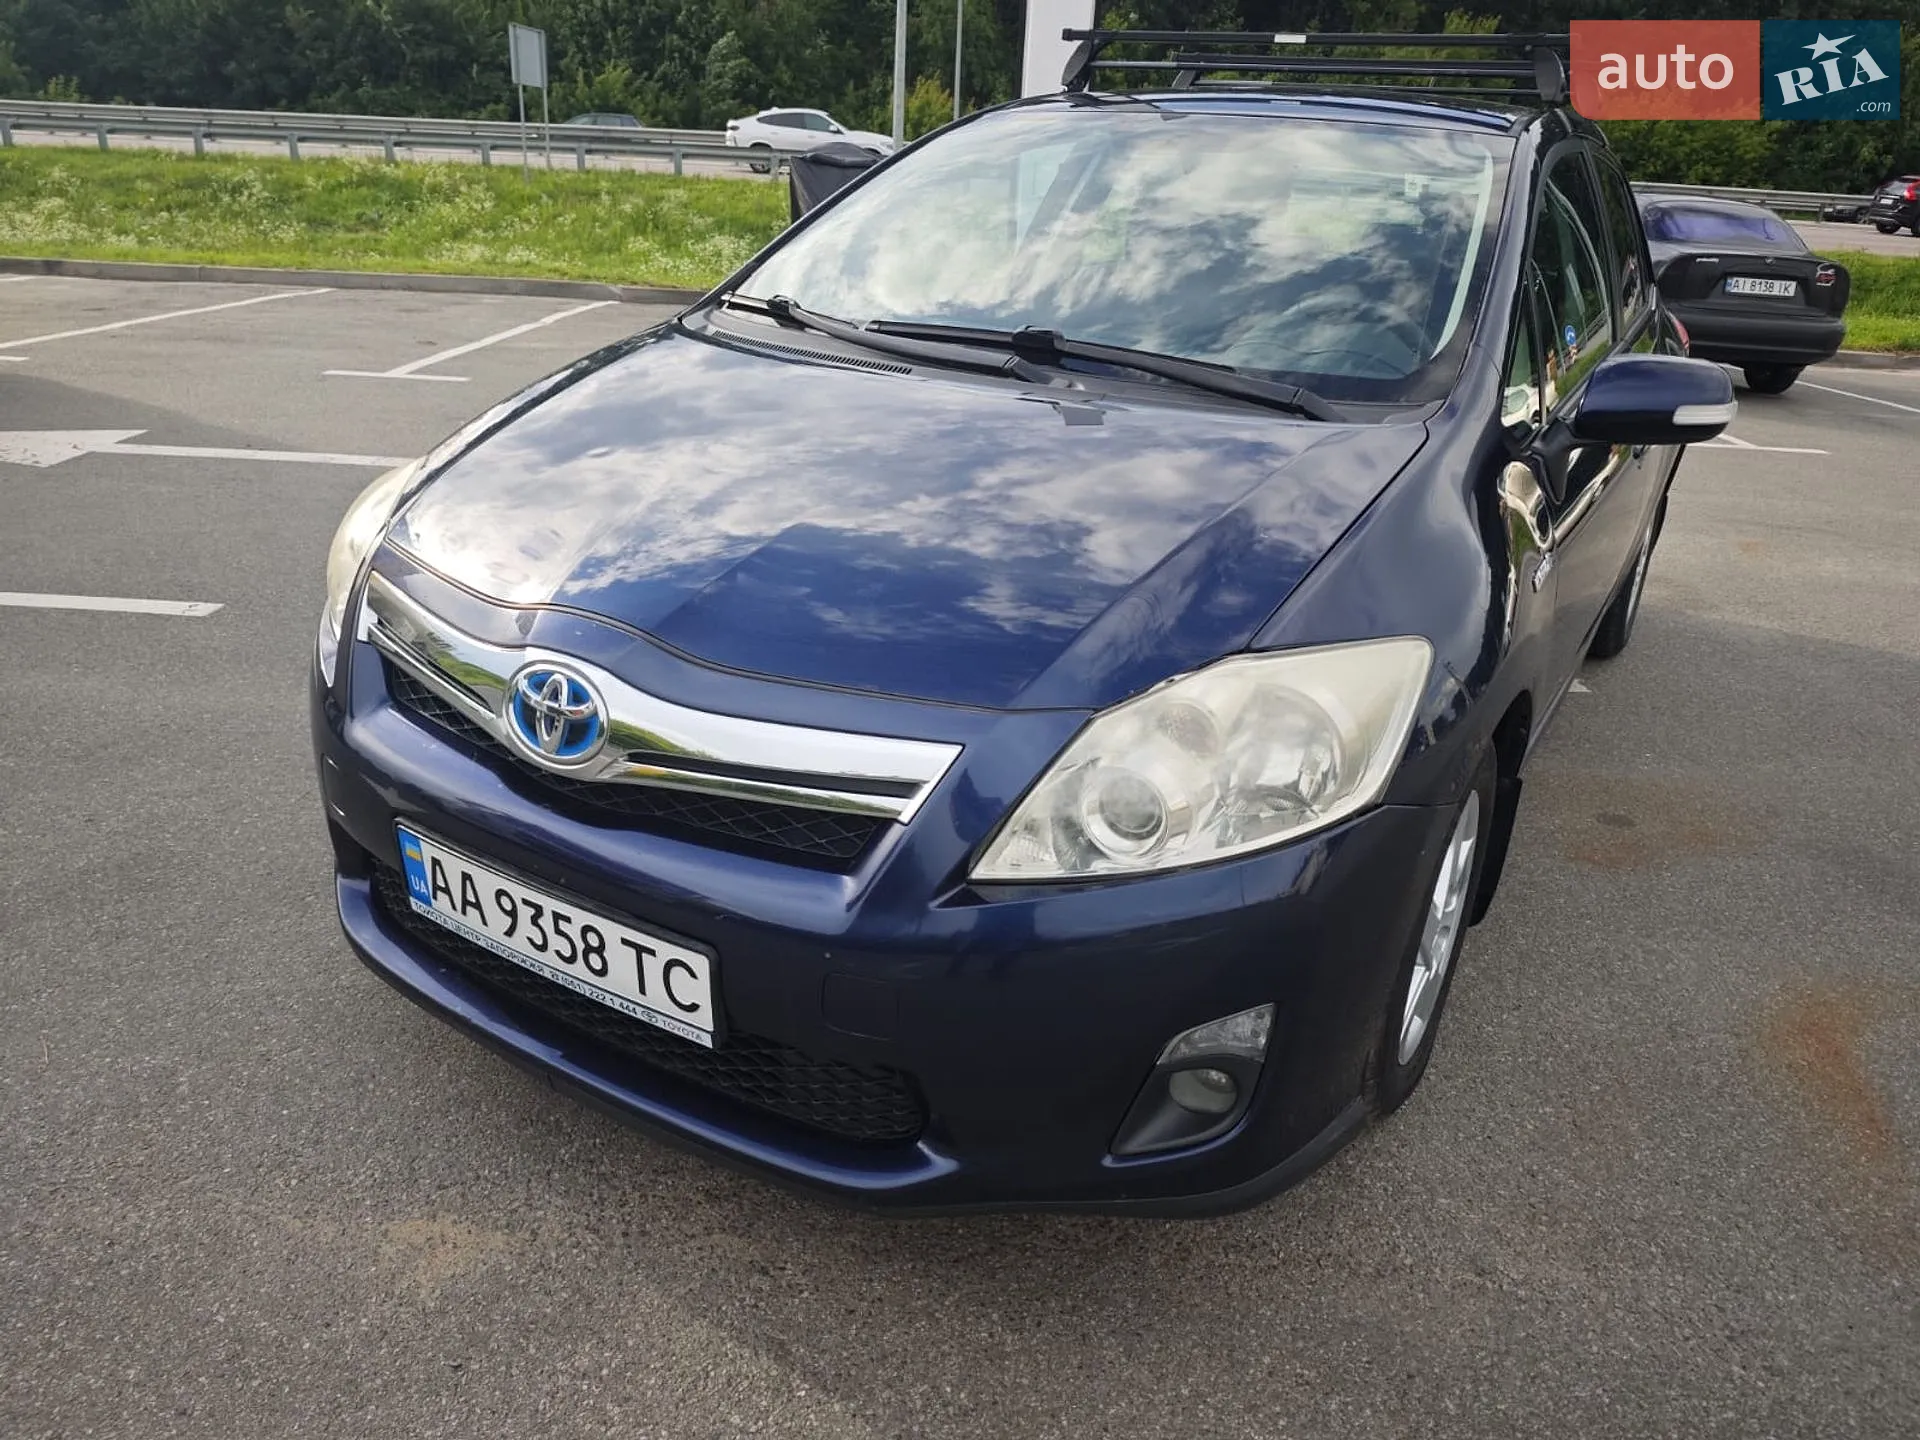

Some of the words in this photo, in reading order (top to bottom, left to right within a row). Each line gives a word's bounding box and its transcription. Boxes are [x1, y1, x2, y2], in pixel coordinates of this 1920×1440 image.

[411, 874, 430, 897] UA
[431, 855, 488, 928] AA
[494, 887, 609, 978] 9358
[620, 936, 701, 1013] TC
